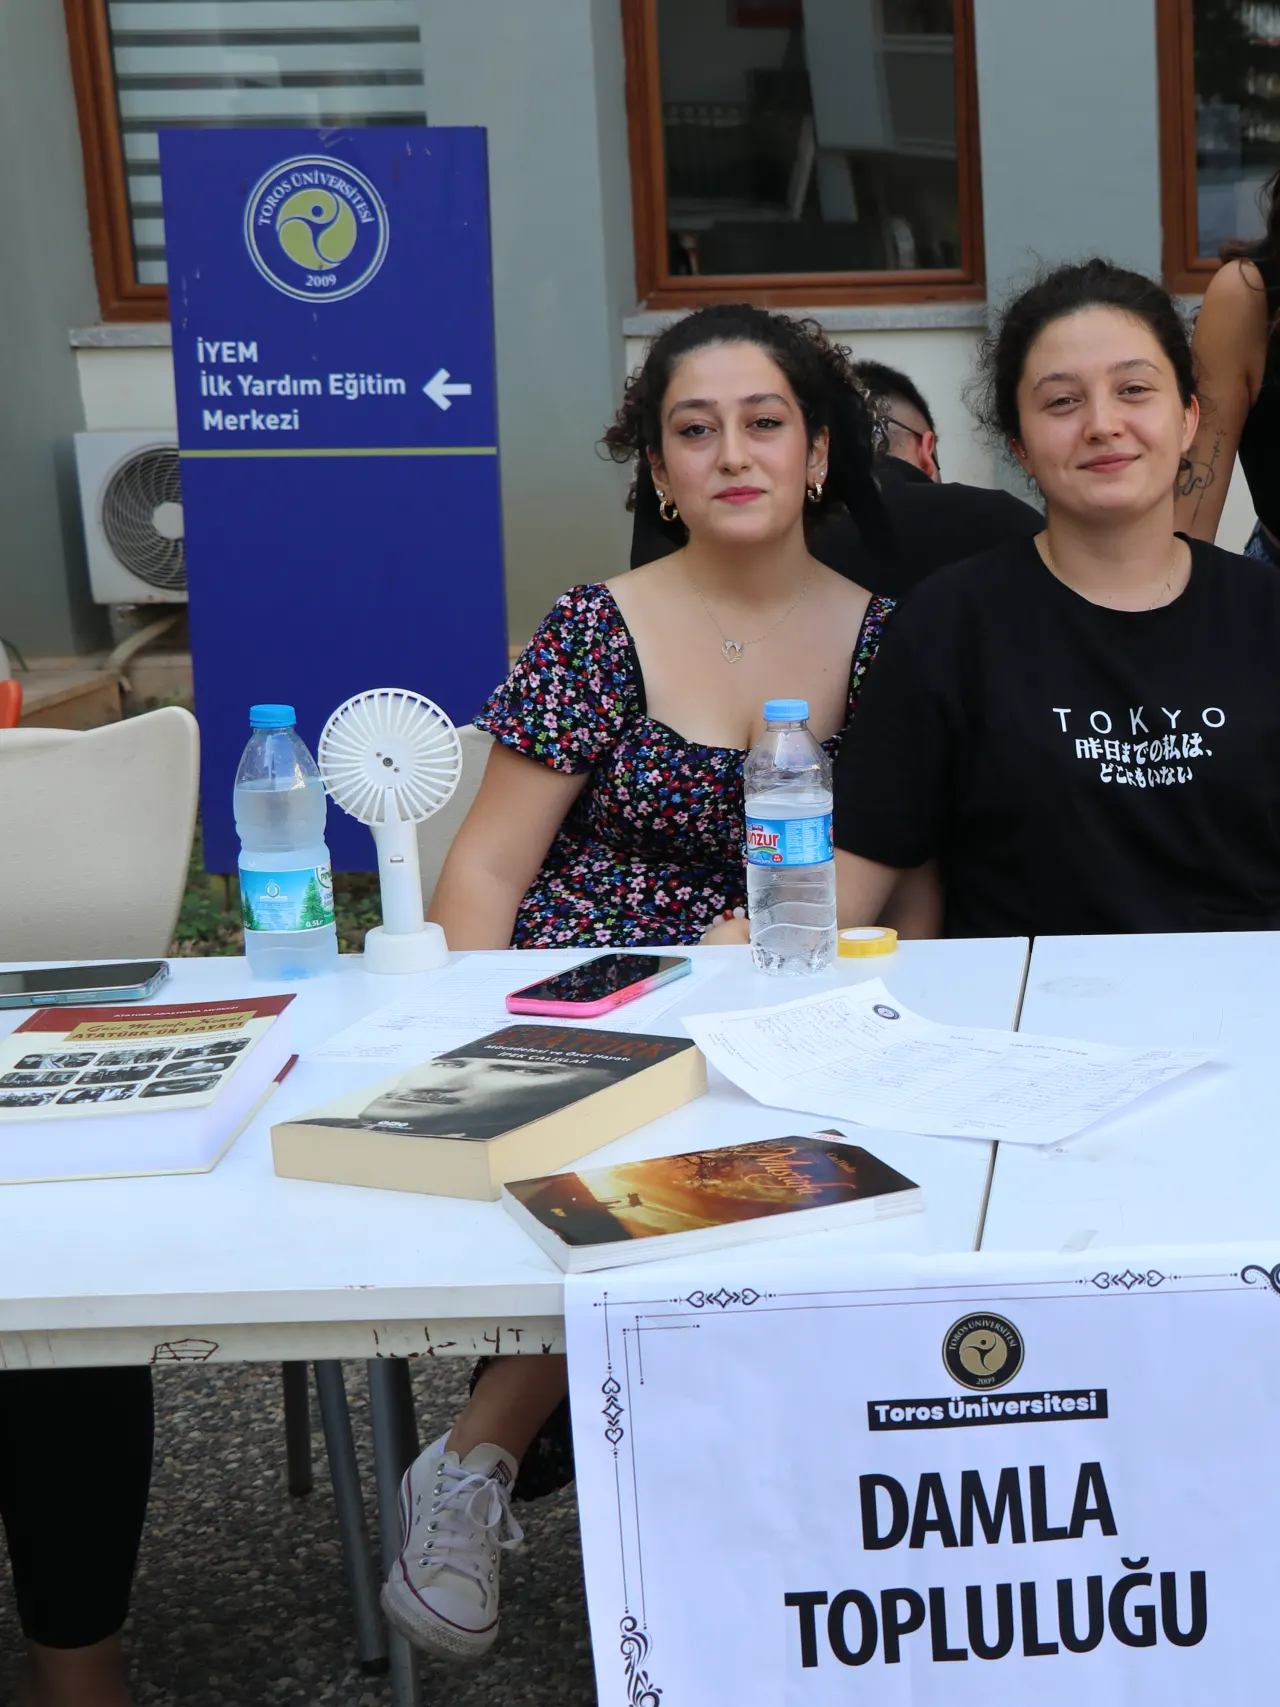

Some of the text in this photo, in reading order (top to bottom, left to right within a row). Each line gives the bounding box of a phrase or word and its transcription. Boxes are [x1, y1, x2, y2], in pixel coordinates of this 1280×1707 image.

[258, 169, 375, 226] TOROS ÜNİVERSİTESİ
[305, 274, 337, 287] 2009
[196, 336, 258, 363] İYEM
[200, 369, 407, 400] İlk Yardım Eğitim
[203, 409, 299, 431] Merkezi
[1052, 706, 1226, 735] TOKYO
[1100, 762, 1193, 788] どこにもいない
[746, 831, 779, 847] nzur
[184, 1021, 244, 1034] HAYATI
[948, 1317, 1019, 1351] TOROS ÜNİVERSİTESİ
[976, 1376, 996, 1385] 2009
[874, 1391, 1097, 1425] Toros Üniversitesi
[858, 1461, 1118, 1551] DAMLA
[784, 1556, 1209, 1668] TOPLULUĞU
